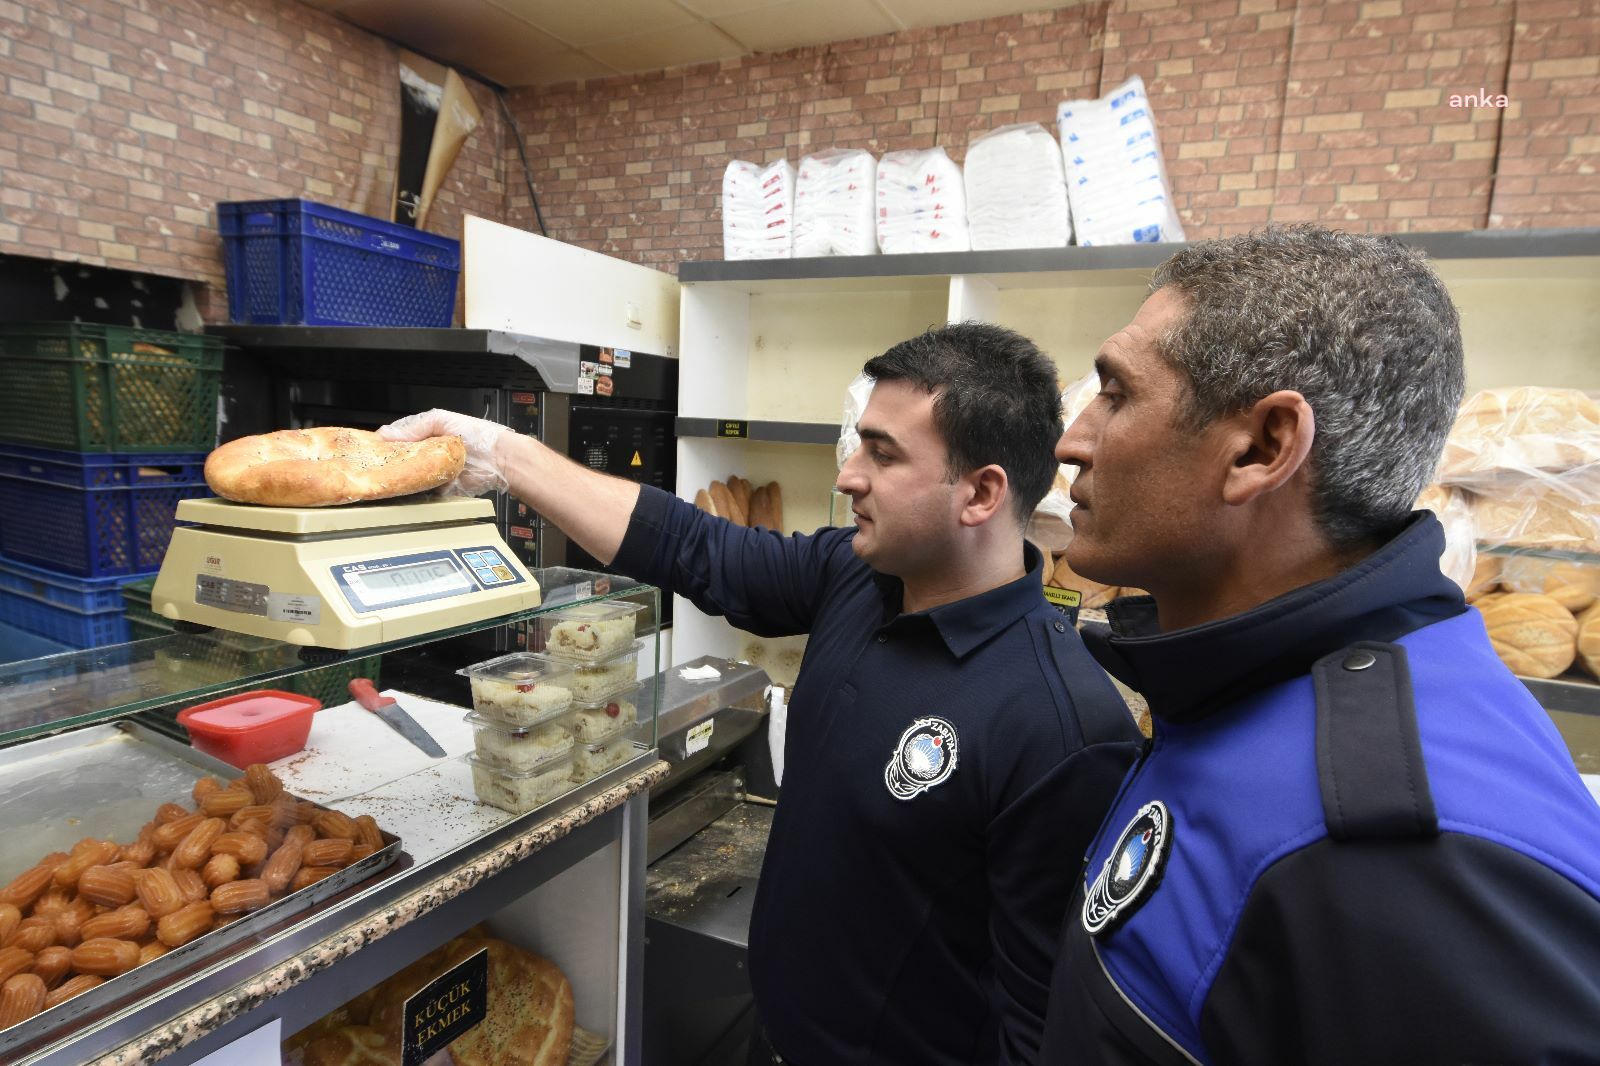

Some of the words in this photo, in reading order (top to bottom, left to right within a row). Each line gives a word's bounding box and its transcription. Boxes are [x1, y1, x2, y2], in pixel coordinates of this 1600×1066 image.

[343, 564, 366, 574] CAS
[930, 721, 955, 751] ZABITA
[415, 979, 472, 1028] KÜÇÜK
[417, 999, 473, 1047] EKMEK
